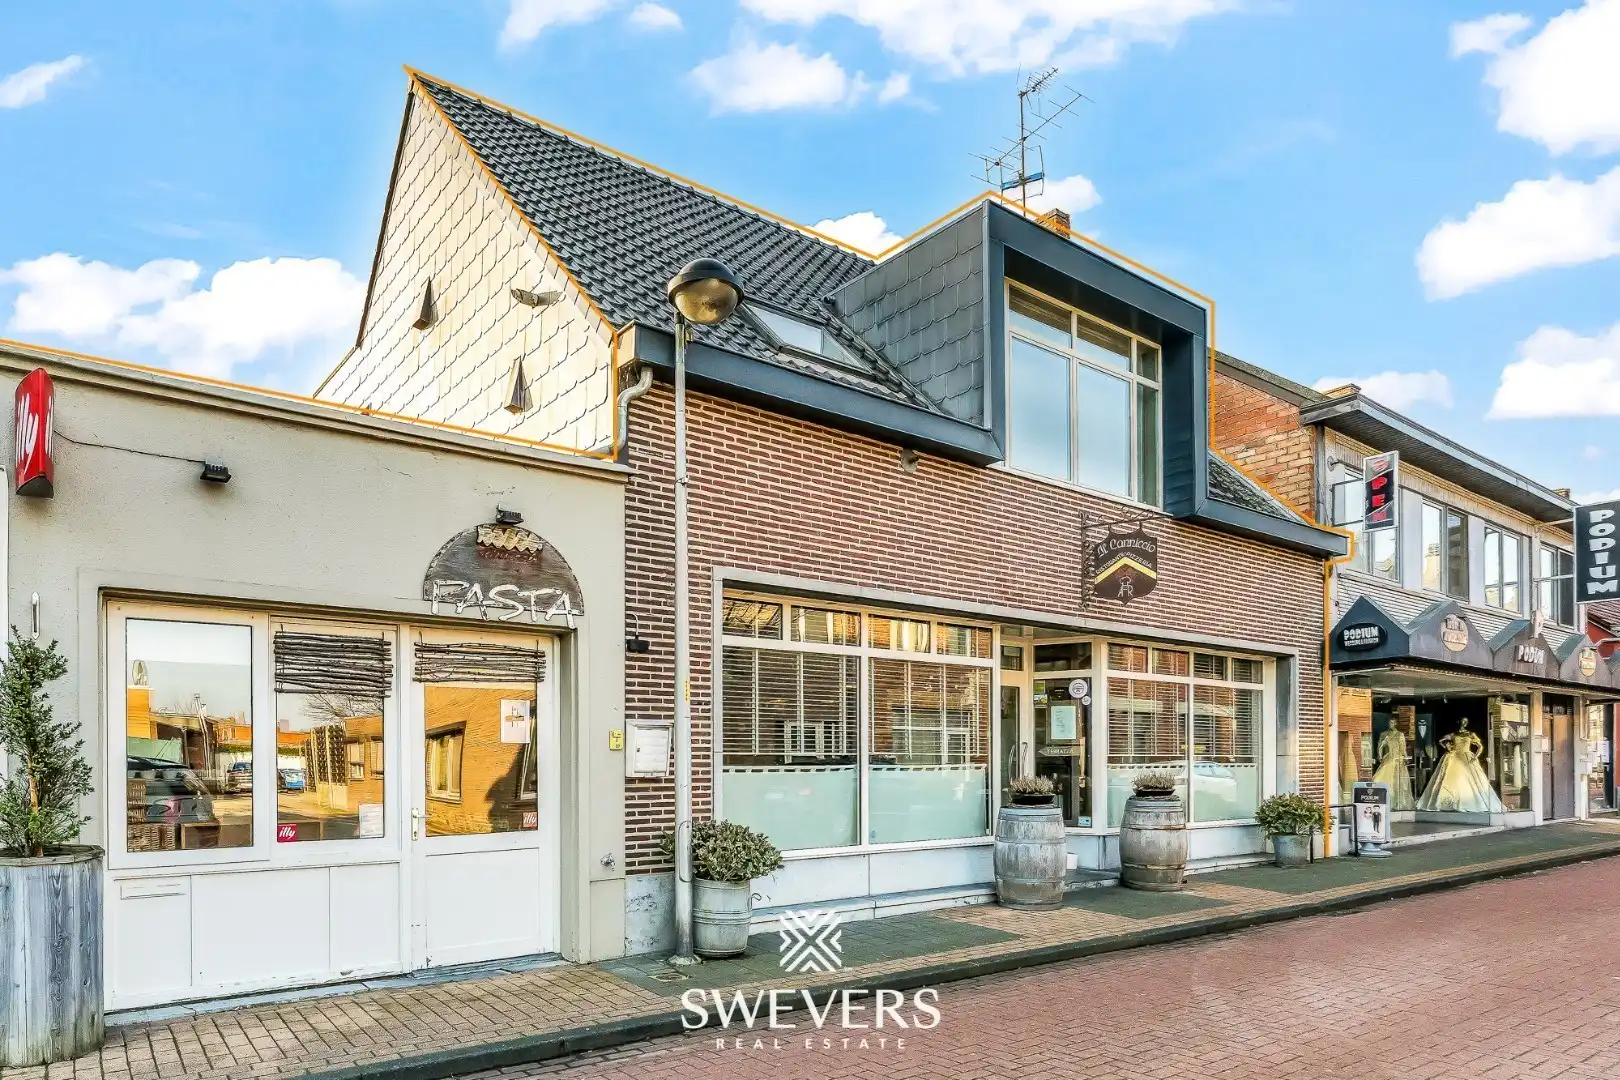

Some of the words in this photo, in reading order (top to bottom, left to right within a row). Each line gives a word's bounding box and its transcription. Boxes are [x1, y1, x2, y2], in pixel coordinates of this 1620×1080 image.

[1586, 509, 1619, 595] PODIUM
[430, 579, 581, 629] PASTA
[1343, 626, 1379, 641] PODIUM
[523, 812, 537, 825] illy
[279, 826, 296, 840] illy
